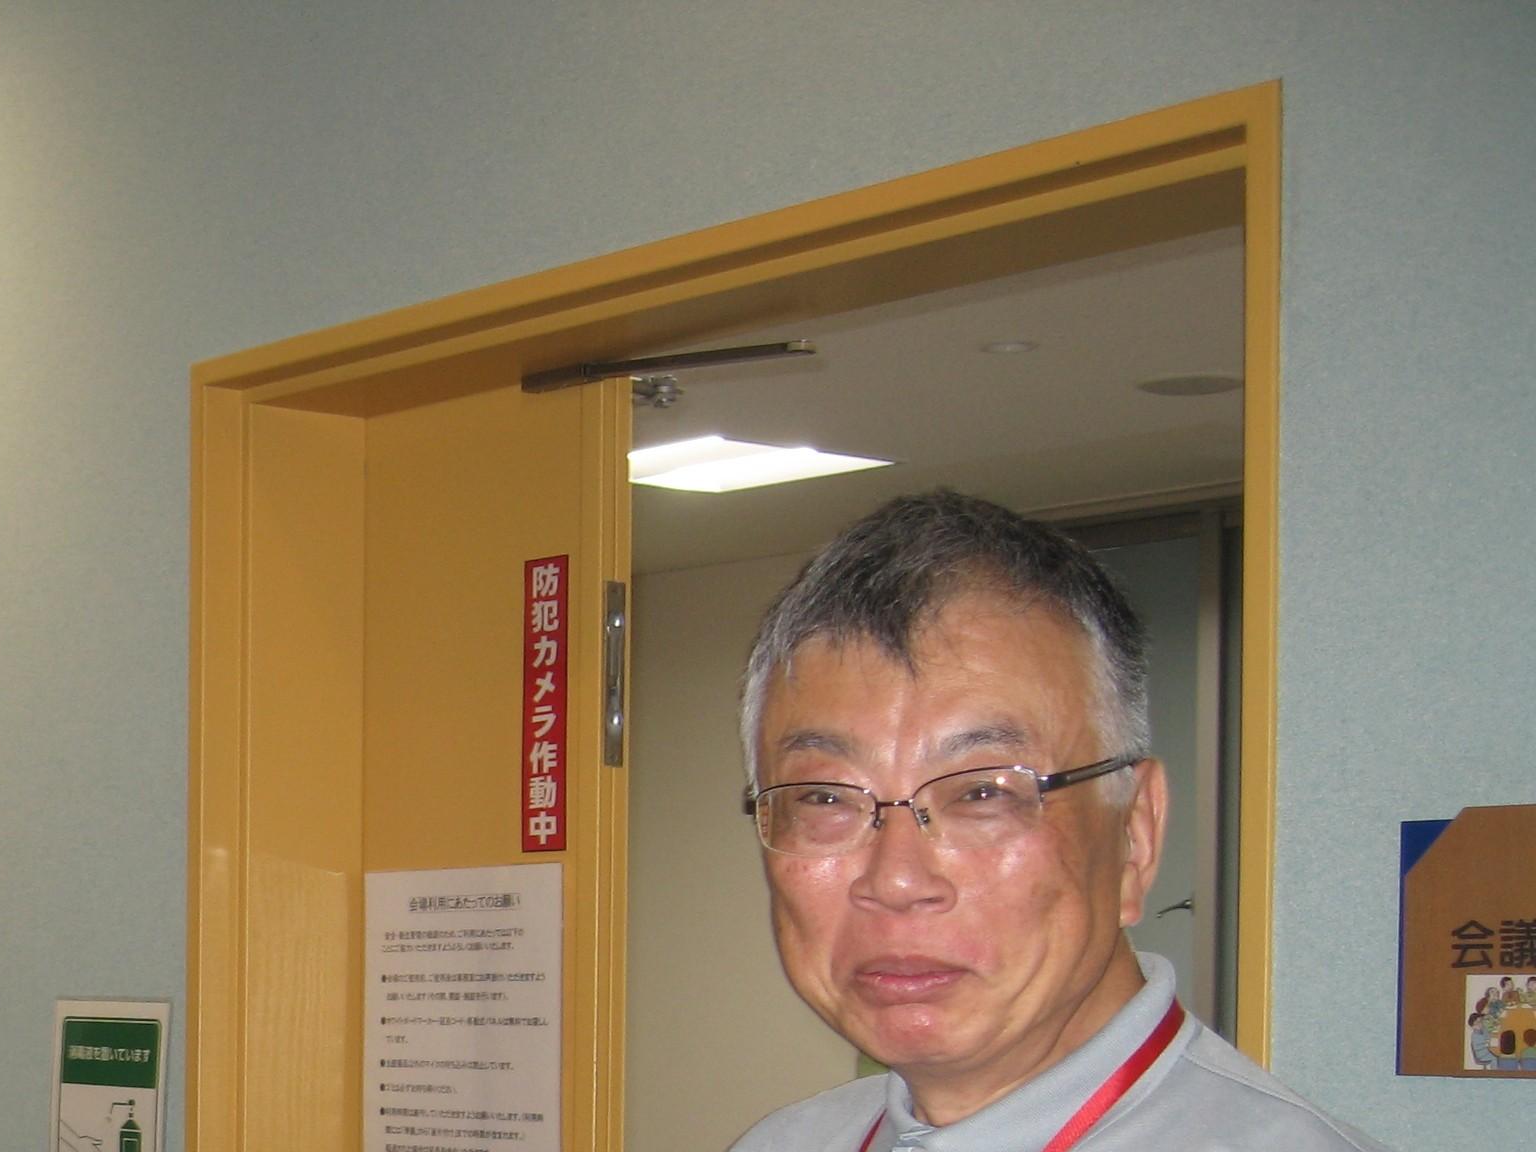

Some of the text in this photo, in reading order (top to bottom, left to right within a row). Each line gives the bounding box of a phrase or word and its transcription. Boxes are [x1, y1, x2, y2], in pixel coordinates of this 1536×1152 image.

[530, 563, 561, 845] 防犯カメラ作動中
[1451, 919, 1536, 969] 会議
